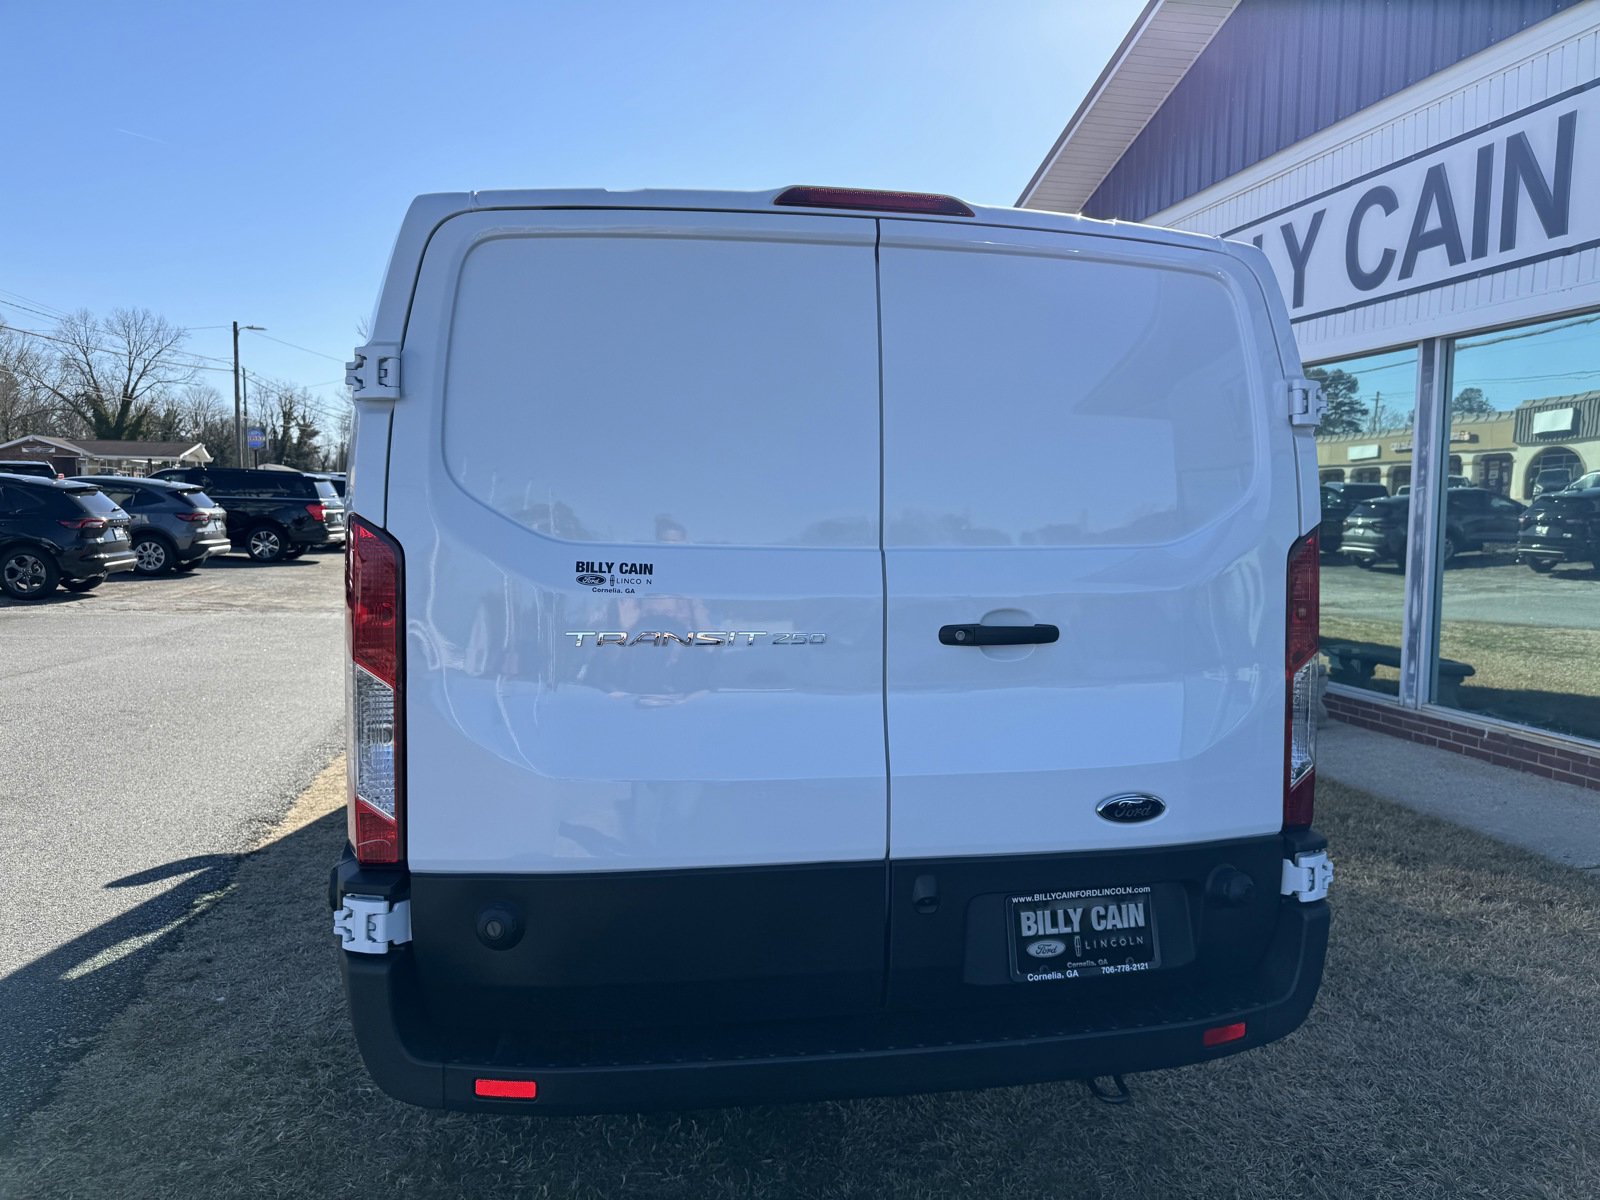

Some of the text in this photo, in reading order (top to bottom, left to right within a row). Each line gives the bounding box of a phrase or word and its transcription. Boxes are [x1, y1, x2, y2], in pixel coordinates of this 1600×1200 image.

[1253, 109, 1578, 309] Y CAIN
[575, 561, 653, 575] BILLY CAIN
[565, 632, 826, 647] TRANSIT 250
[1115, 800, 1151, 817] Ford
[1012, 886, 1150, 903] www.BILLYCAINFORDLINCOLN.com
[1020, 903, 1145, 937] BILLY CAIN
[1035, 944, 1058, 955] Ford
[1085, 936, 1144, 950] LINCOLN
[1066, 969, 1079, 978] GA
[1101, 963, 1149, 974] 706-778-2121
